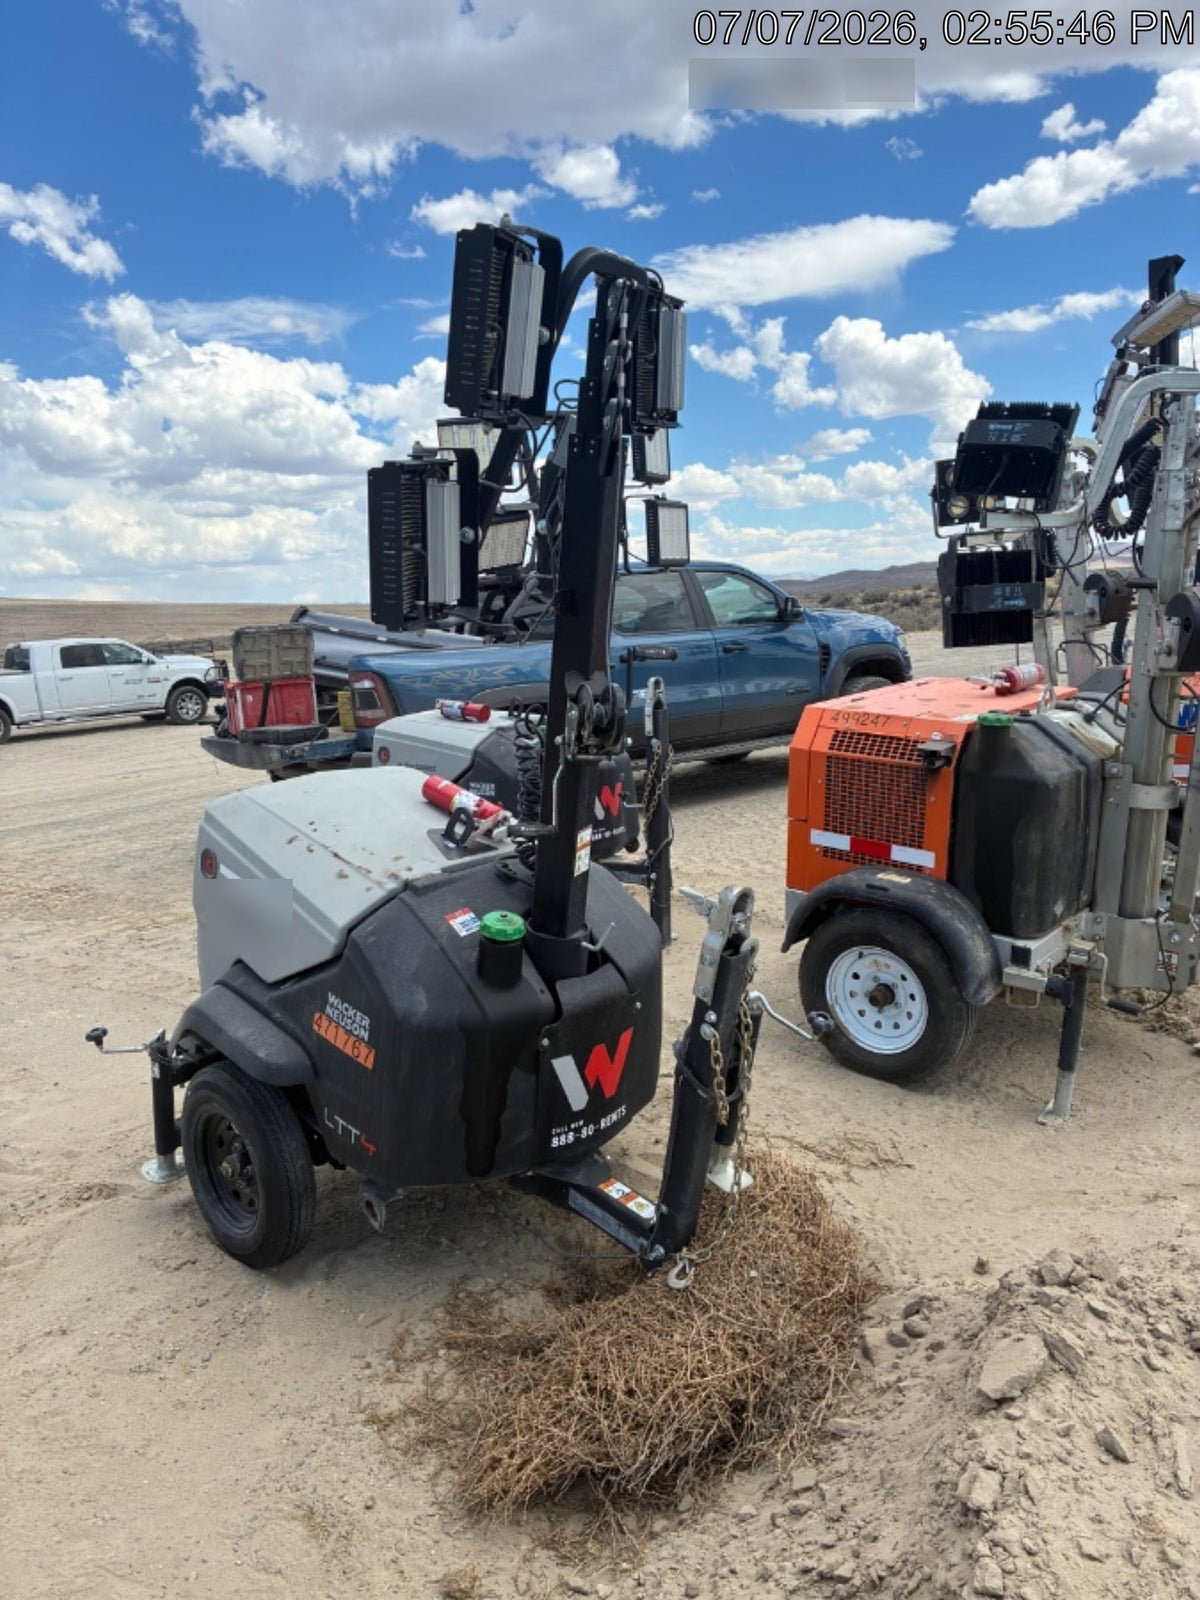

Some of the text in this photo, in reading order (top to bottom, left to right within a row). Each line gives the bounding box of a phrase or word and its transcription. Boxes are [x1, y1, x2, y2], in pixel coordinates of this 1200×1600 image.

[831, 710, 892, 728] 499247
[325, 1003, 370, 1042] NEUSON
[327, 991, 370, 1030] WACKER
[313, 1014, 374, 1065] 471767
[551, 1104, 628, 1148] 888-80-RENTS
